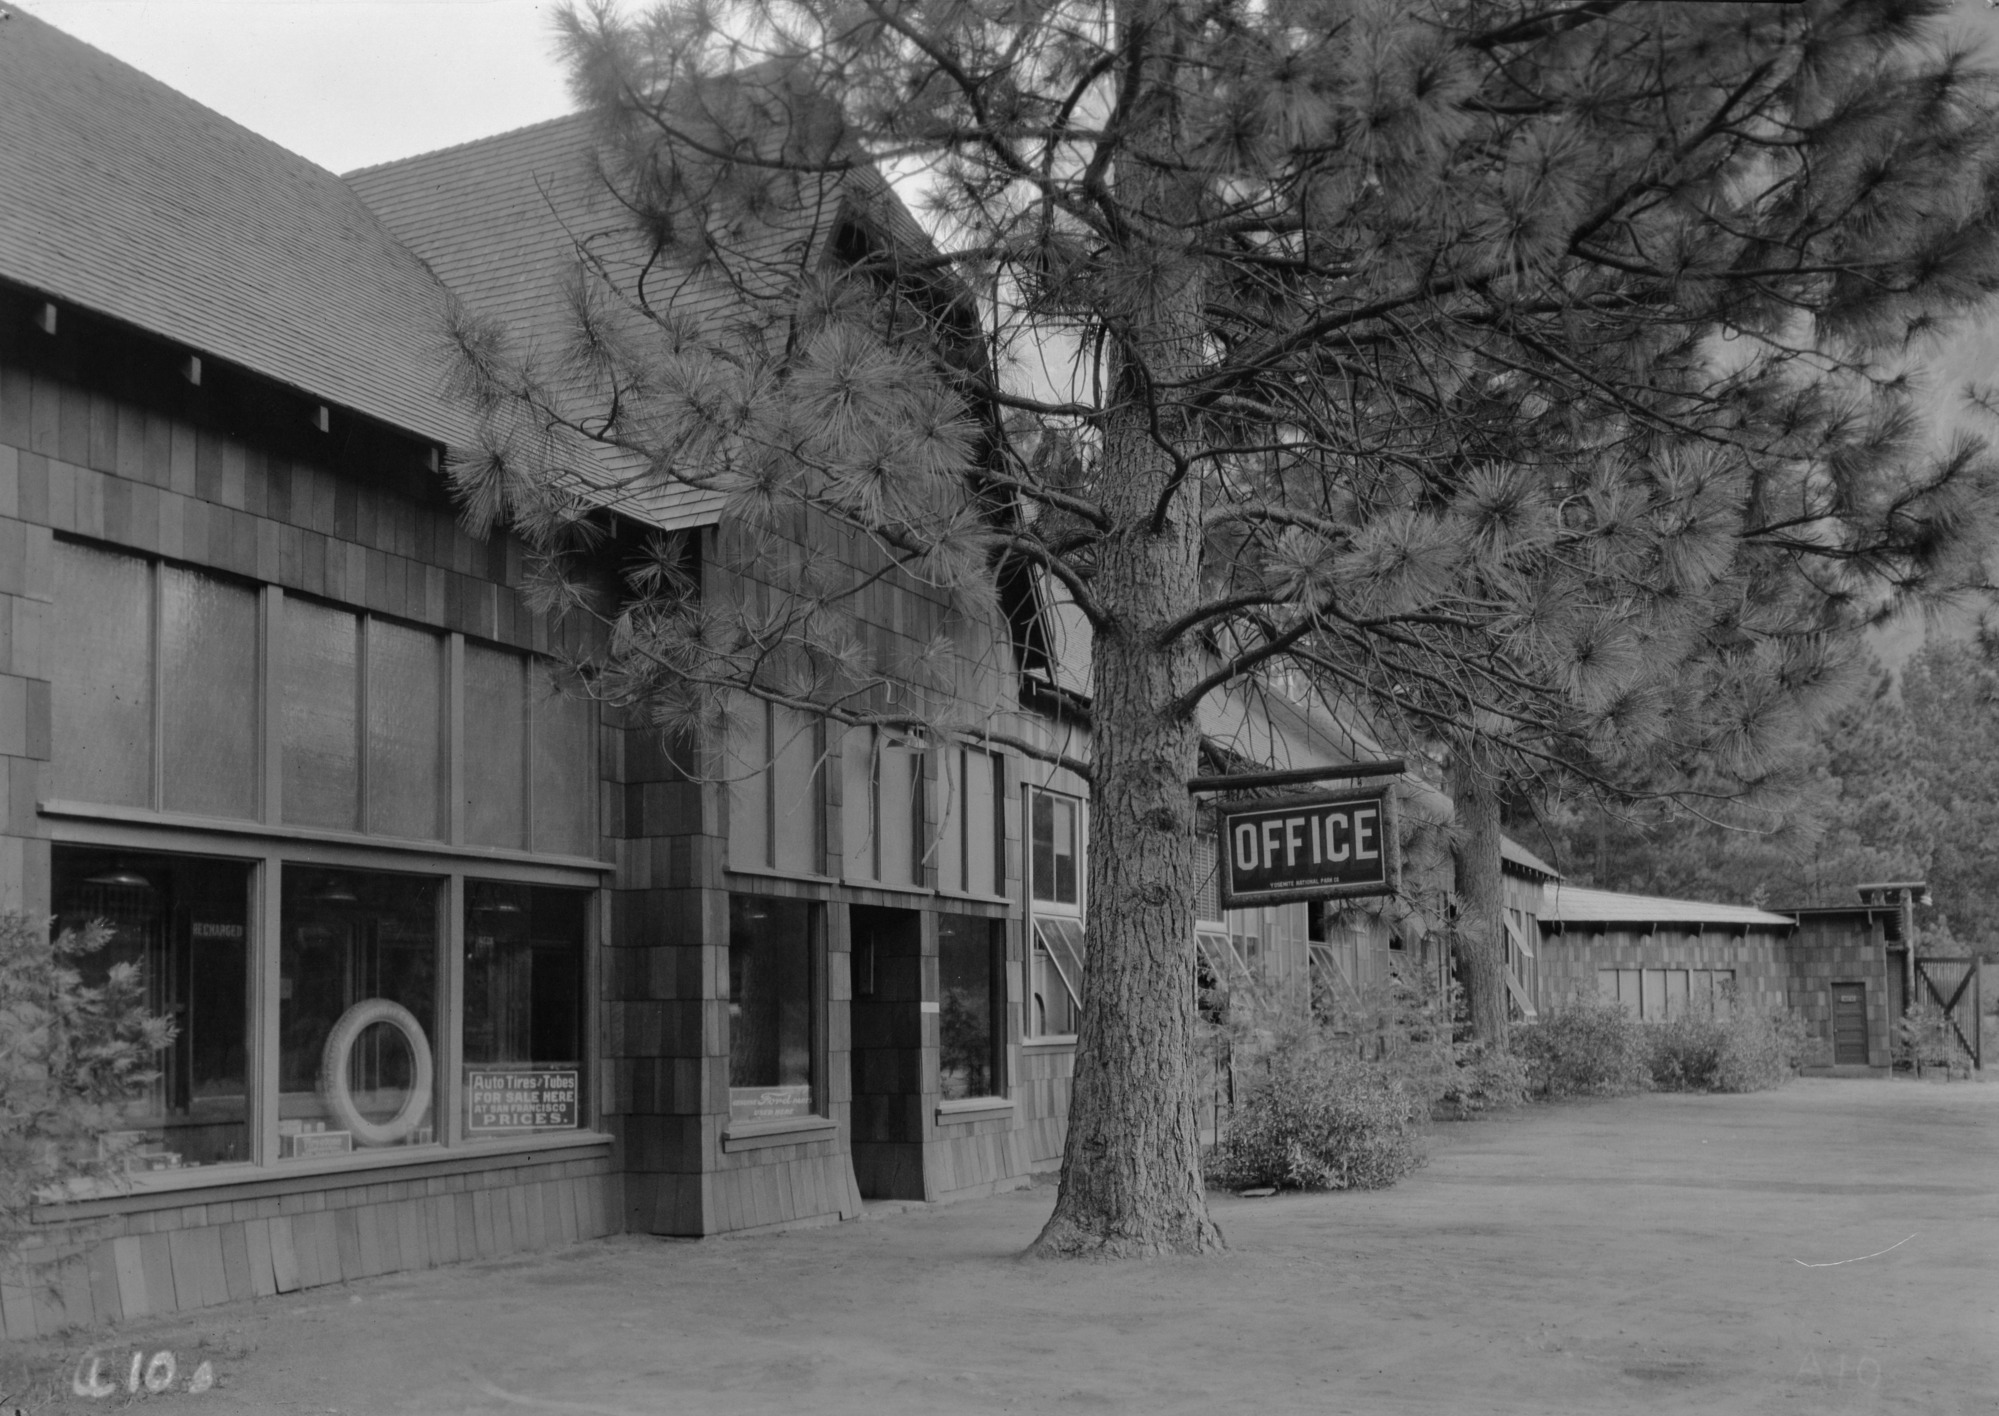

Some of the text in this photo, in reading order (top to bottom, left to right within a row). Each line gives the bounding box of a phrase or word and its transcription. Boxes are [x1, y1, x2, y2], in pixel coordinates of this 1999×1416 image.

[1235, 808, 1379, 871] OFFICE
[1269, 880, 1294, 889] YOSEMITE
[474, 1075, 505, 1089] Auto
[506, 1075, 537, 1089] Tires
[543, 1075, 575, 1089] Tubes
[474, 1091, 574, 1103] FOR SALE HERE
[757, 1092, 792, 1106] Ford
[474, 1103, 567, 1114] AT SAN FRANCISCO
[483, 1113, 568, 1125] PRICES.
